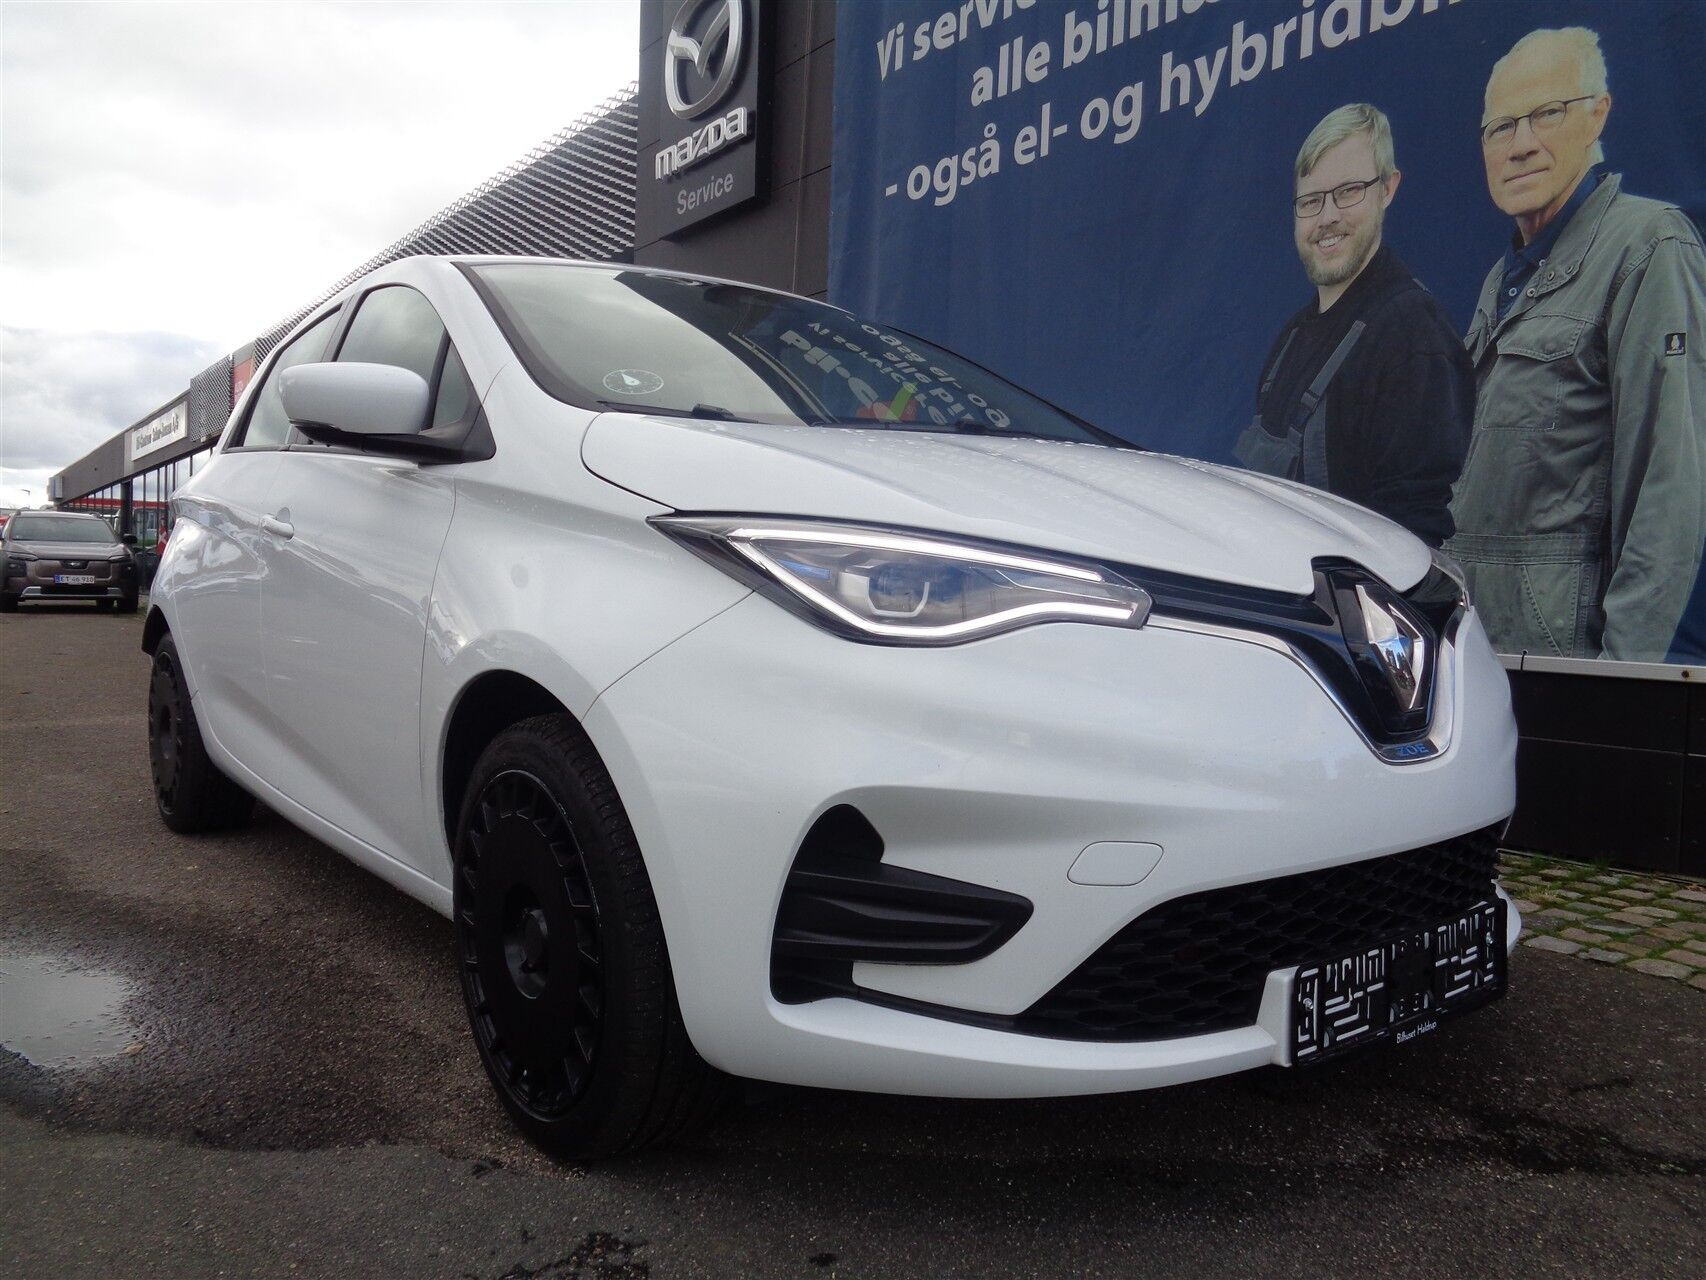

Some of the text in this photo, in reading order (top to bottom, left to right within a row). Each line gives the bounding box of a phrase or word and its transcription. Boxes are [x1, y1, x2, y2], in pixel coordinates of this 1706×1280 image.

[876, 0, 1037, 82] Vi serv
[970, 0, 1222, 107] alle bilm
[885, 184, 898, 196] -
[906, 122, 1000, 207] også
[1014, 102, 1068, 165] el-
[1080, 82, 1143, 144] og
[677, 173, 734, 215] Service
